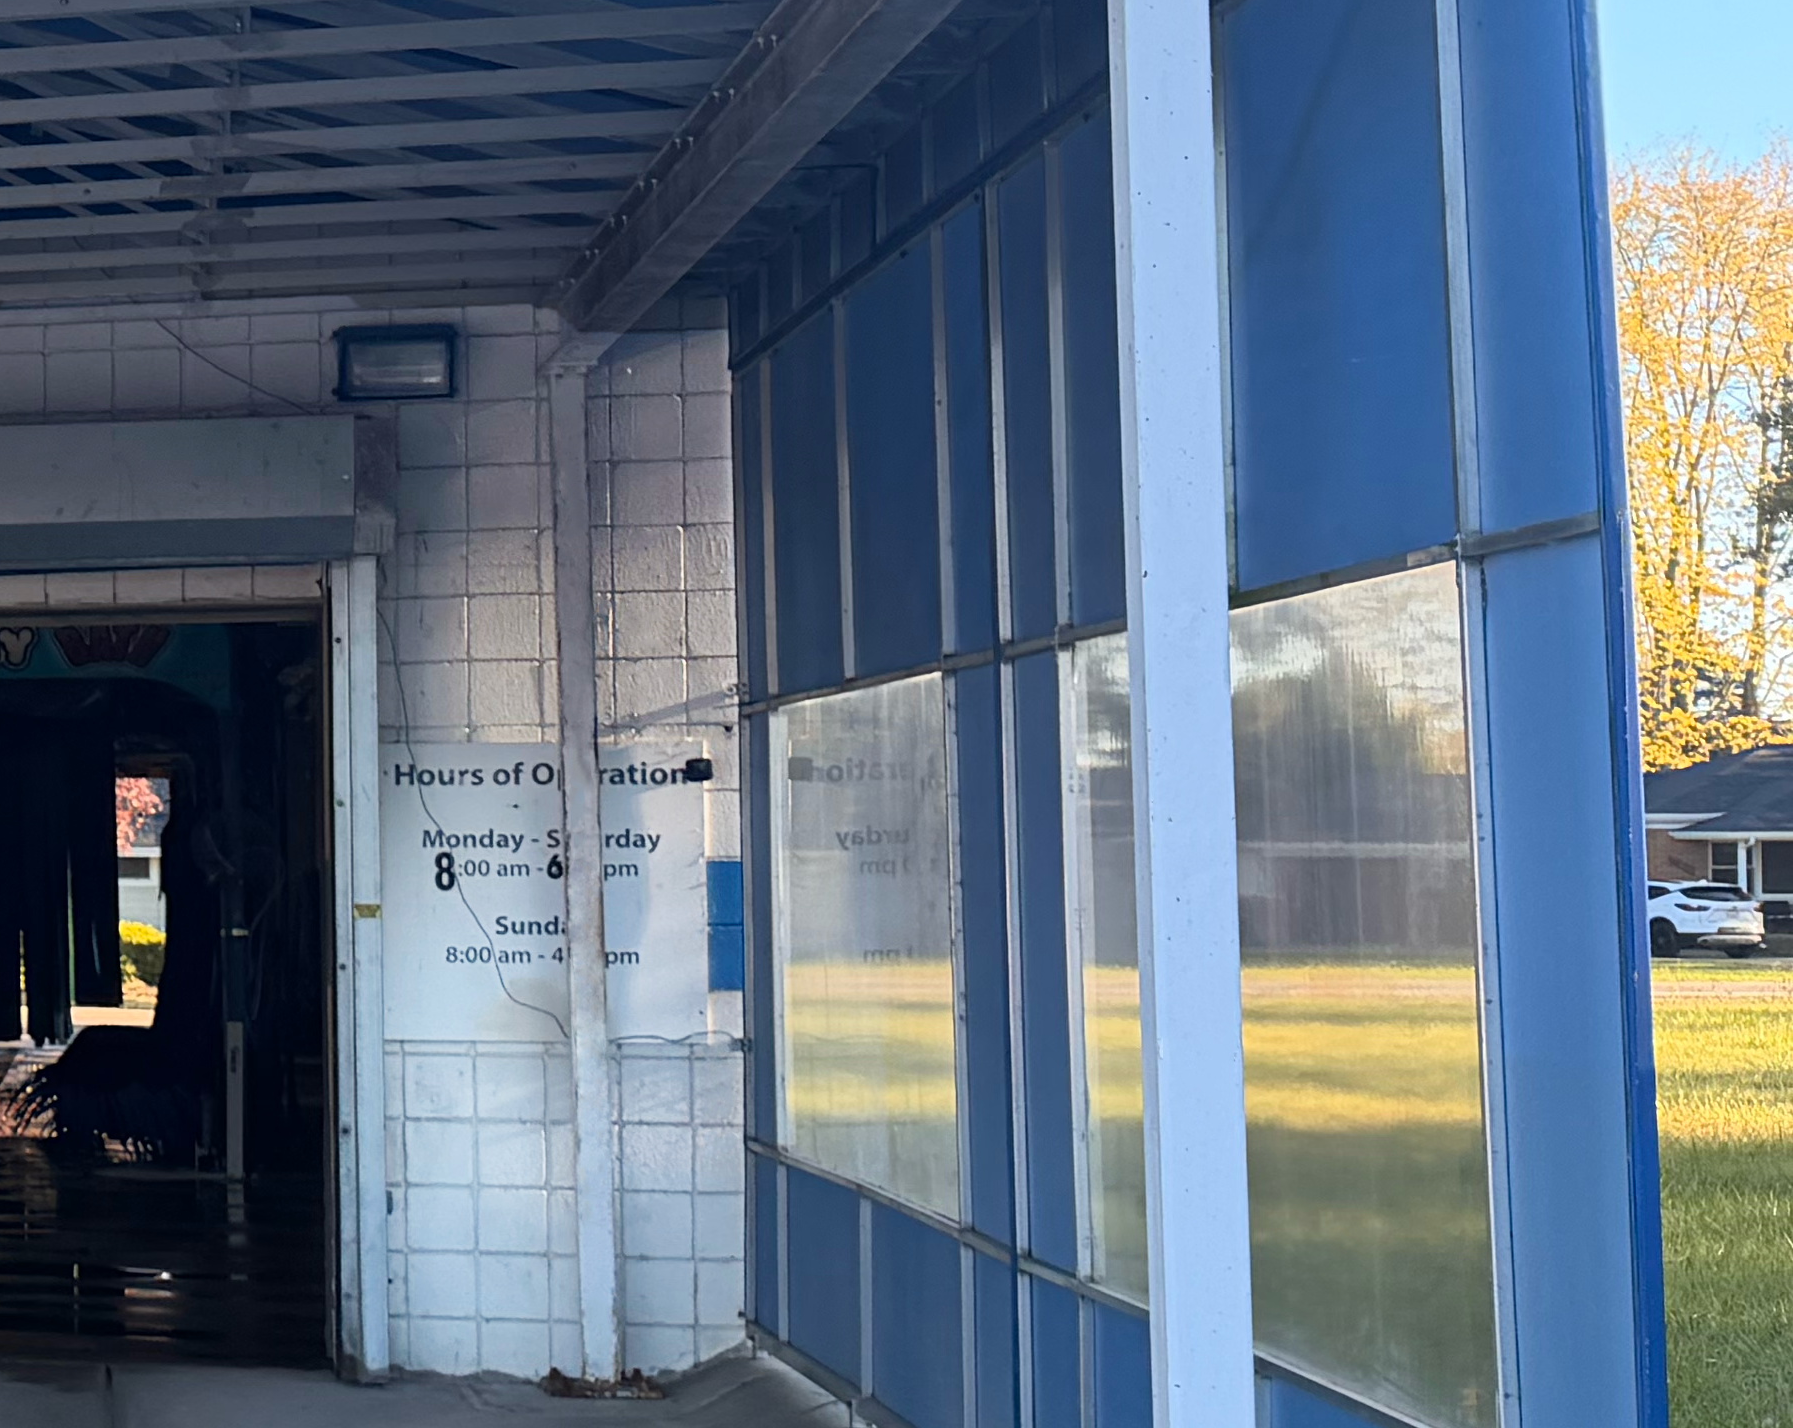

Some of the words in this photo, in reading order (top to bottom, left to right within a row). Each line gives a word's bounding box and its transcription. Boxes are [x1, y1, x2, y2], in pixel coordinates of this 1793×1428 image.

[394, 763, 484, 786] Hours
[492, 762, 524, 786] of
[422, 829, 524, 853] Monday
[546, 829, 661, 854] Srday
[496, 863, 530, 877] am
[603, 863, 639, 881] pm
[495, 915, 566, 936] Sund
[445, 946, 492, 964] 8:00
[498, 949, 531, 964] am
[604, 949, 640, 968] pm
